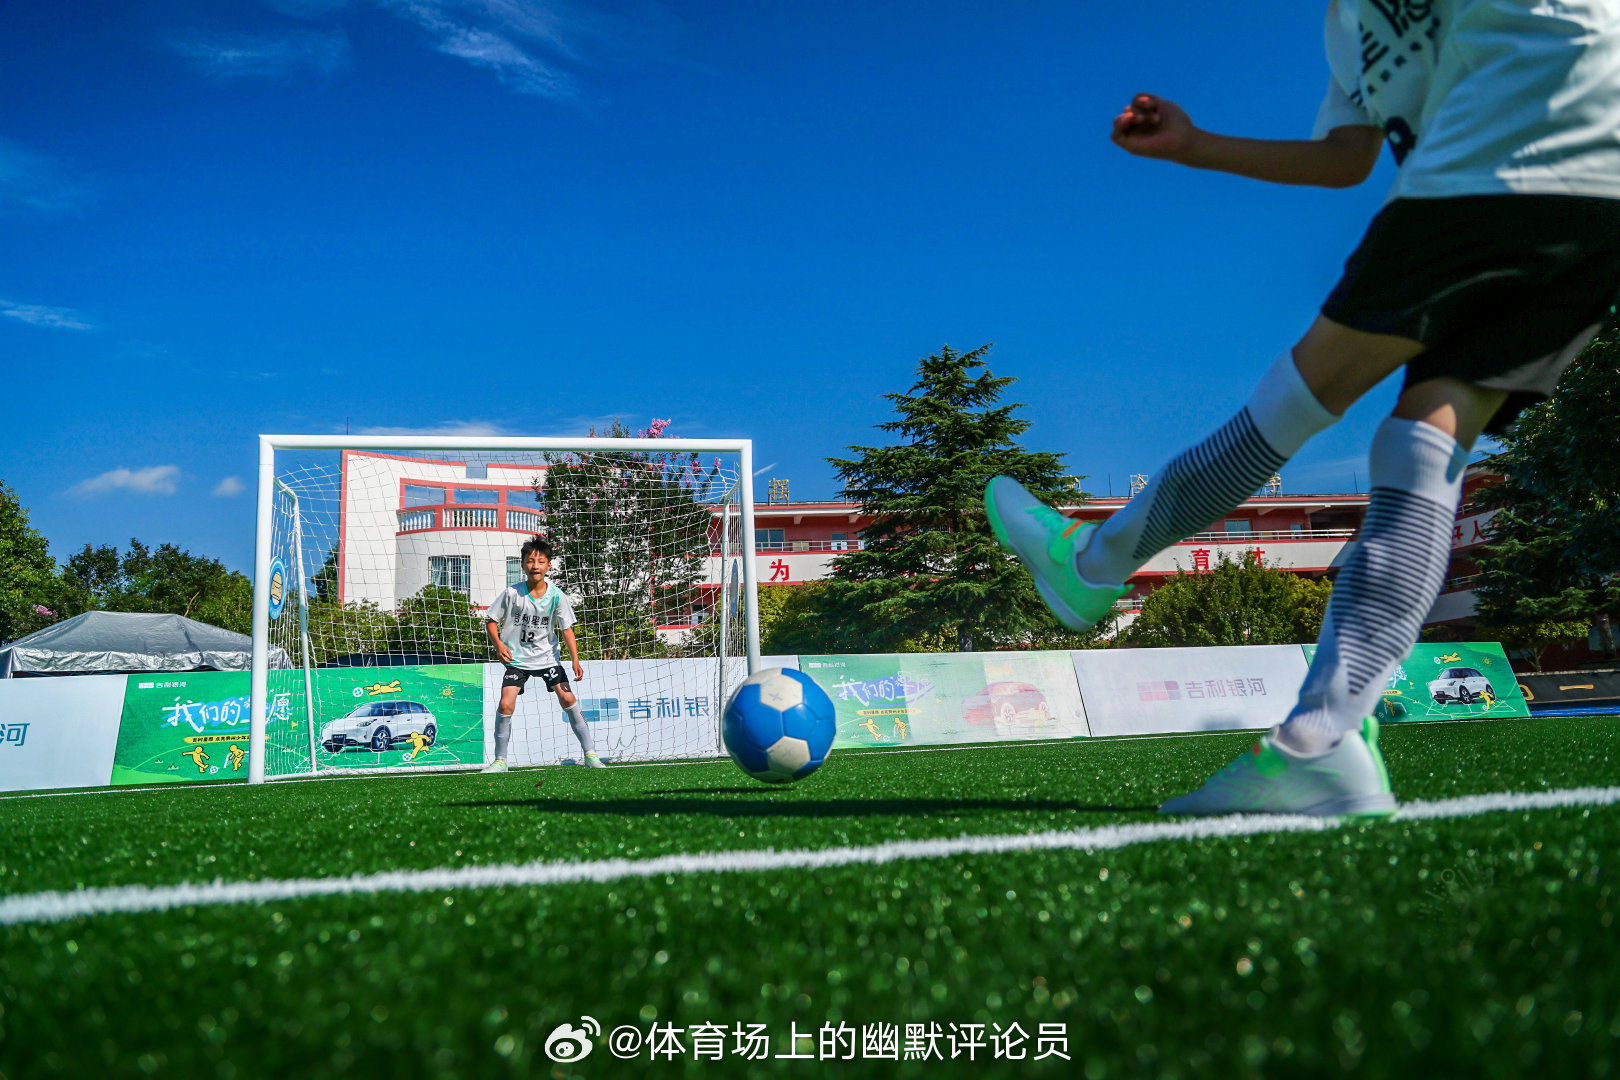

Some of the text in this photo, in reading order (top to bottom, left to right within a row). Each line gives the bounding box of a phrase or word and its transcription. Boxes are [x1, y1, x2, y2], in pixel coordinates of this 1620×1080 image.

[770, 558, 790, 582] 为
[520, 630, 536, 643] 12
[1184, 677, 1268, 700] 吉利银河
[161, 692, 294, 733] 我们的愿
[627, 695, 719, 720] 吉利银
